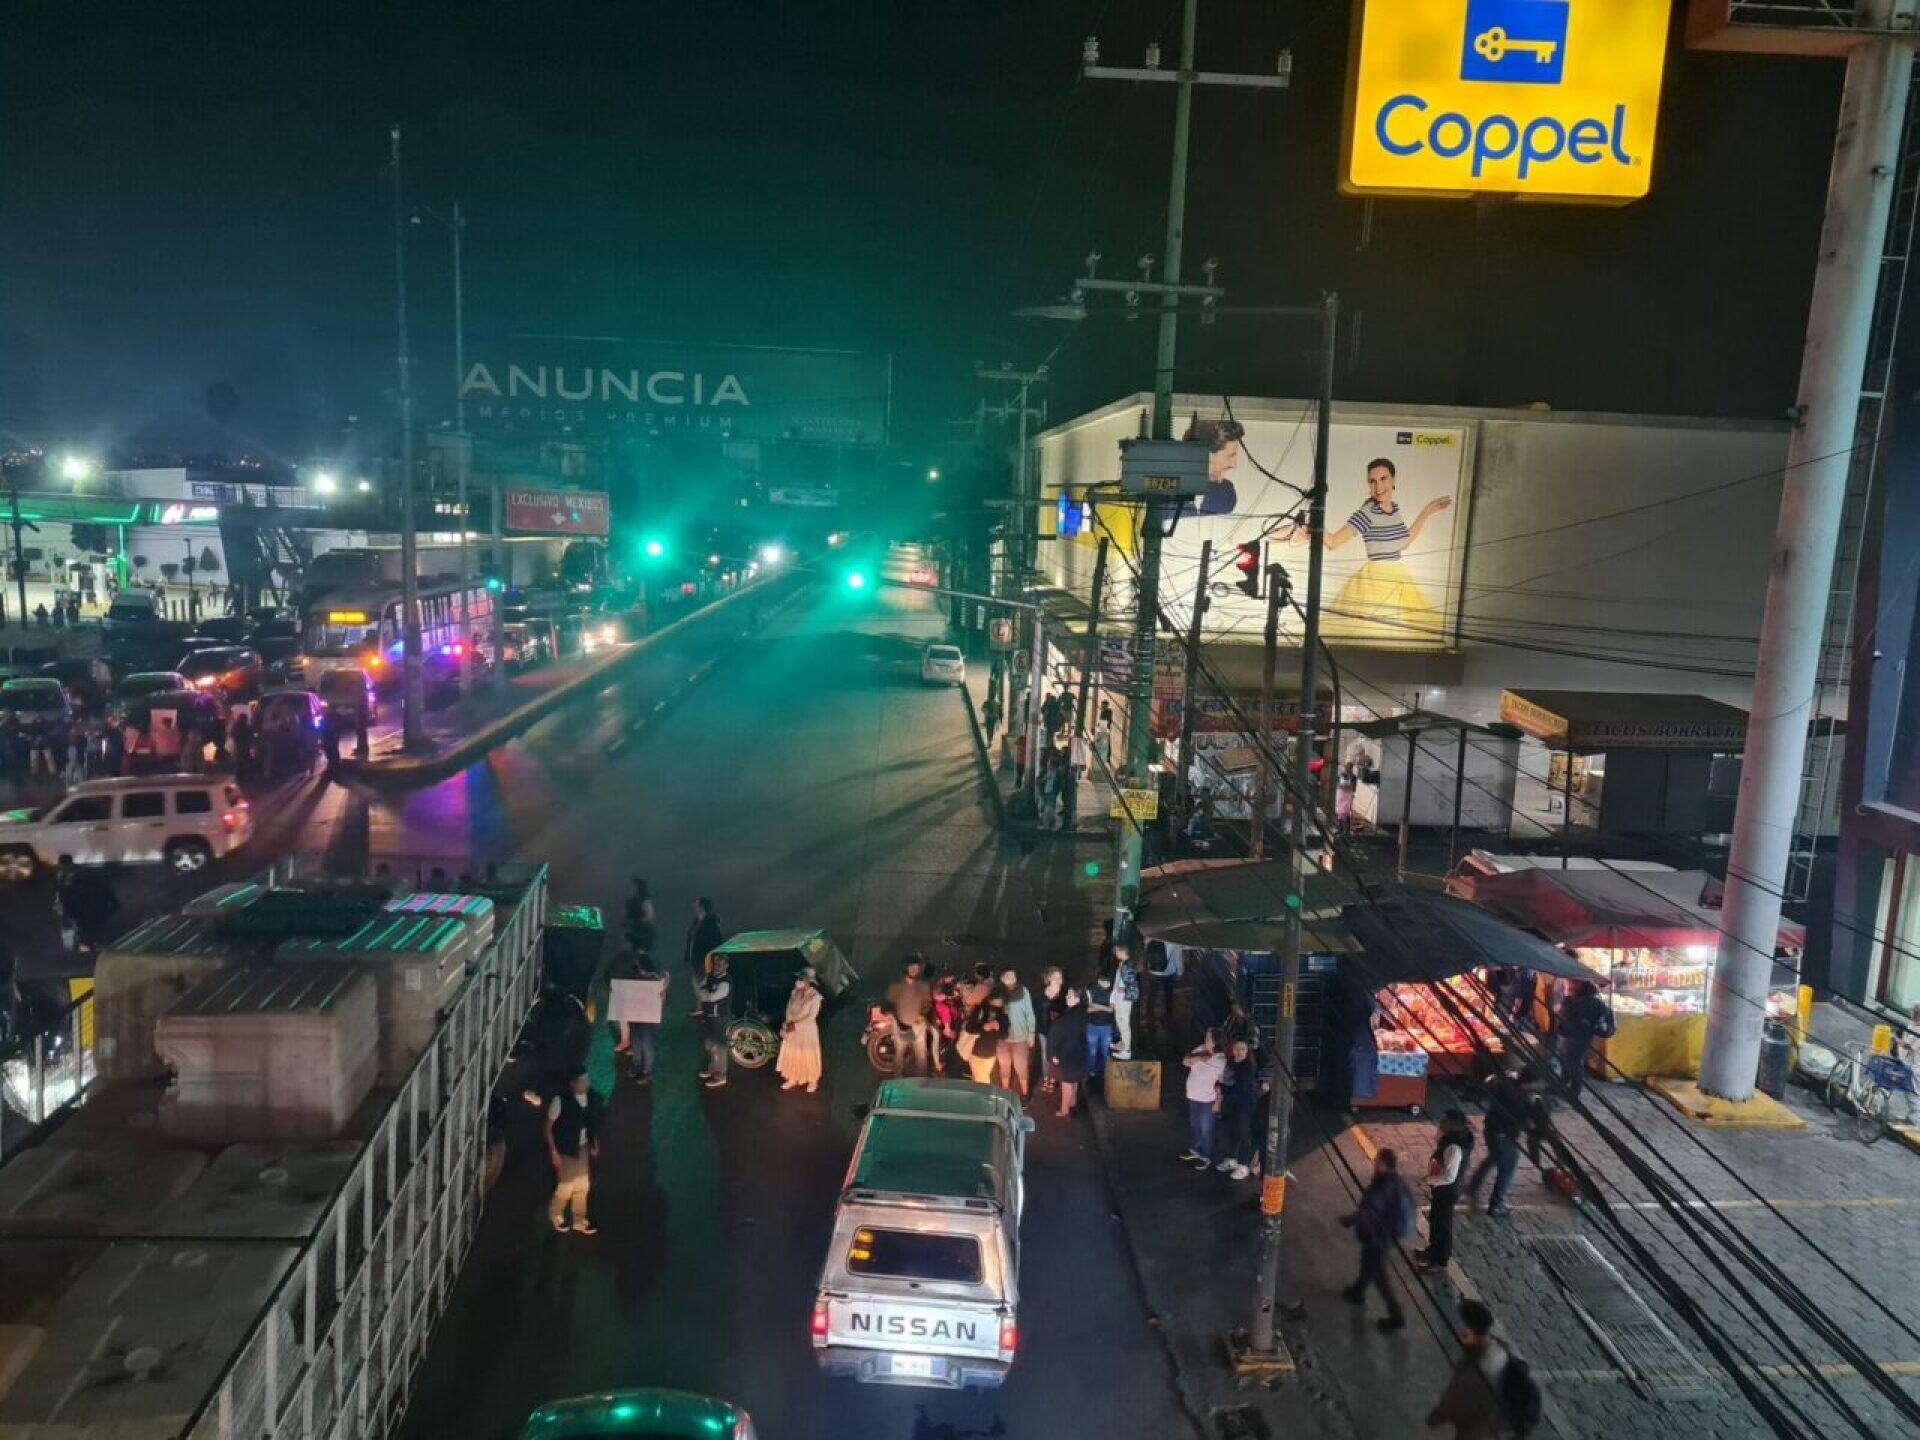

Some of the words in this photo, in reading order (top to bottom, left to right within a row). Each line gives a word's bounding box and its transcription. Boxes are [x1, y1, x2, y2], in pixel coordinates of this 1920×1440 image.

[1375, 94, 1631, 180] Coppel
[460, 362, 751, 406] ANUNCIA
[1416, 433, 1451, 448] Coppel
[851, 1312, 977, 1342] NISSAN
